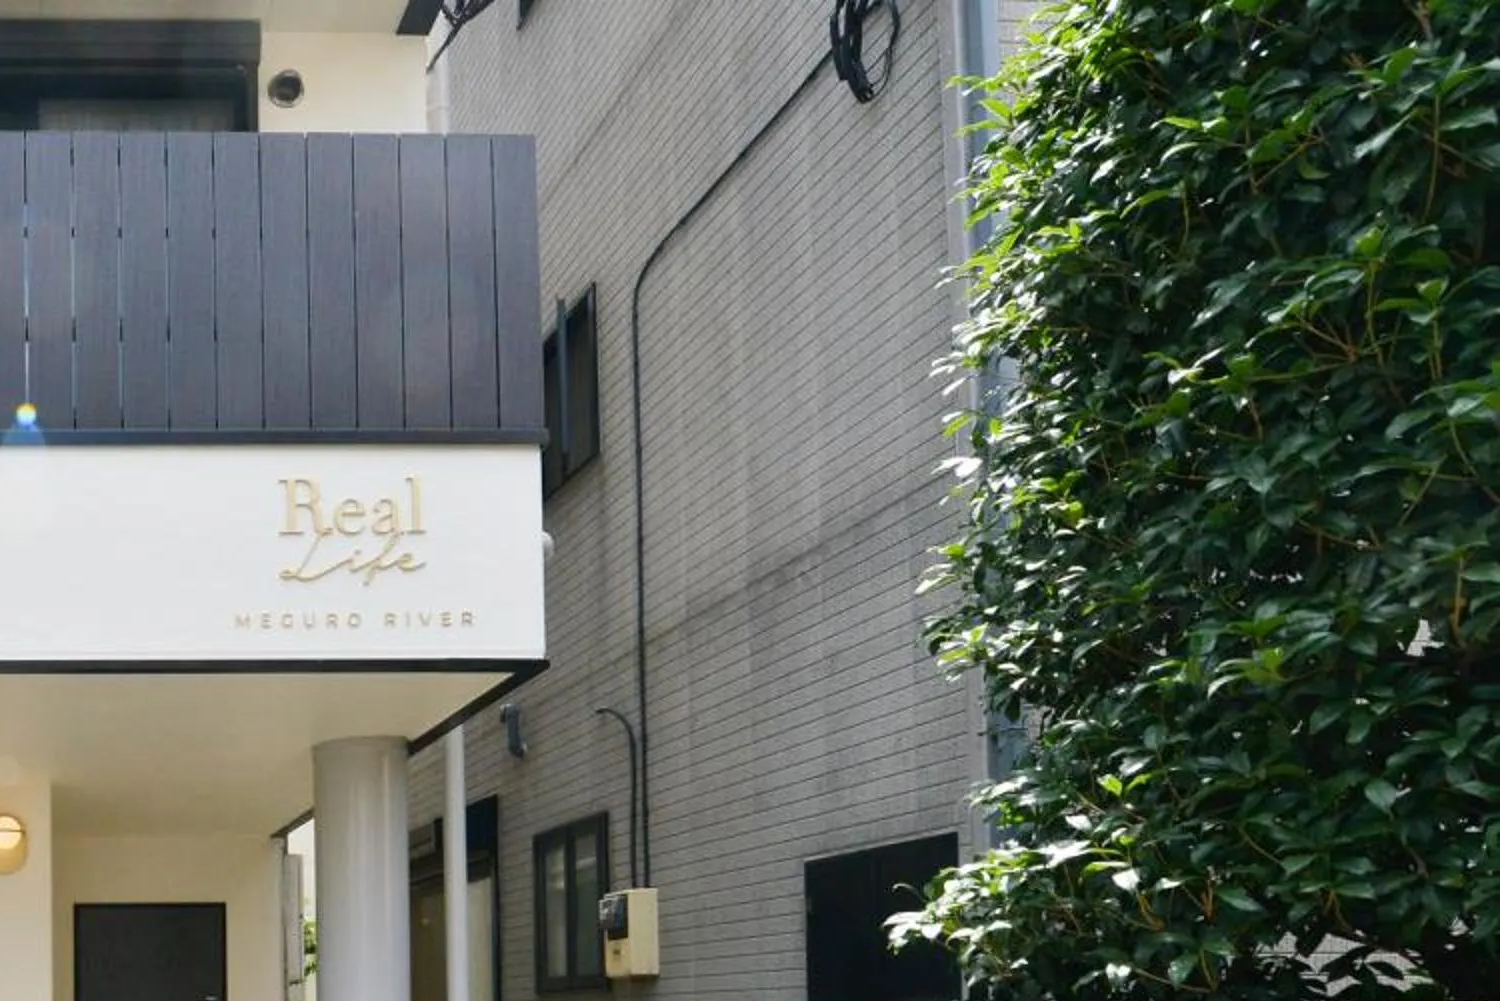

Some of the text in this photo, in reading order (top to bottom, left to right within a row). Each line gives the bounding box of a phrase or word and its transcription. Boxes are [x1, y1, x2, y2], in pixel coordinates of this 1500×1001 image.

[278, 475, 427, 536] Real
[278, 531, 427, 587] Life
[234, 611, 476, 630] MEGURO RIVER
